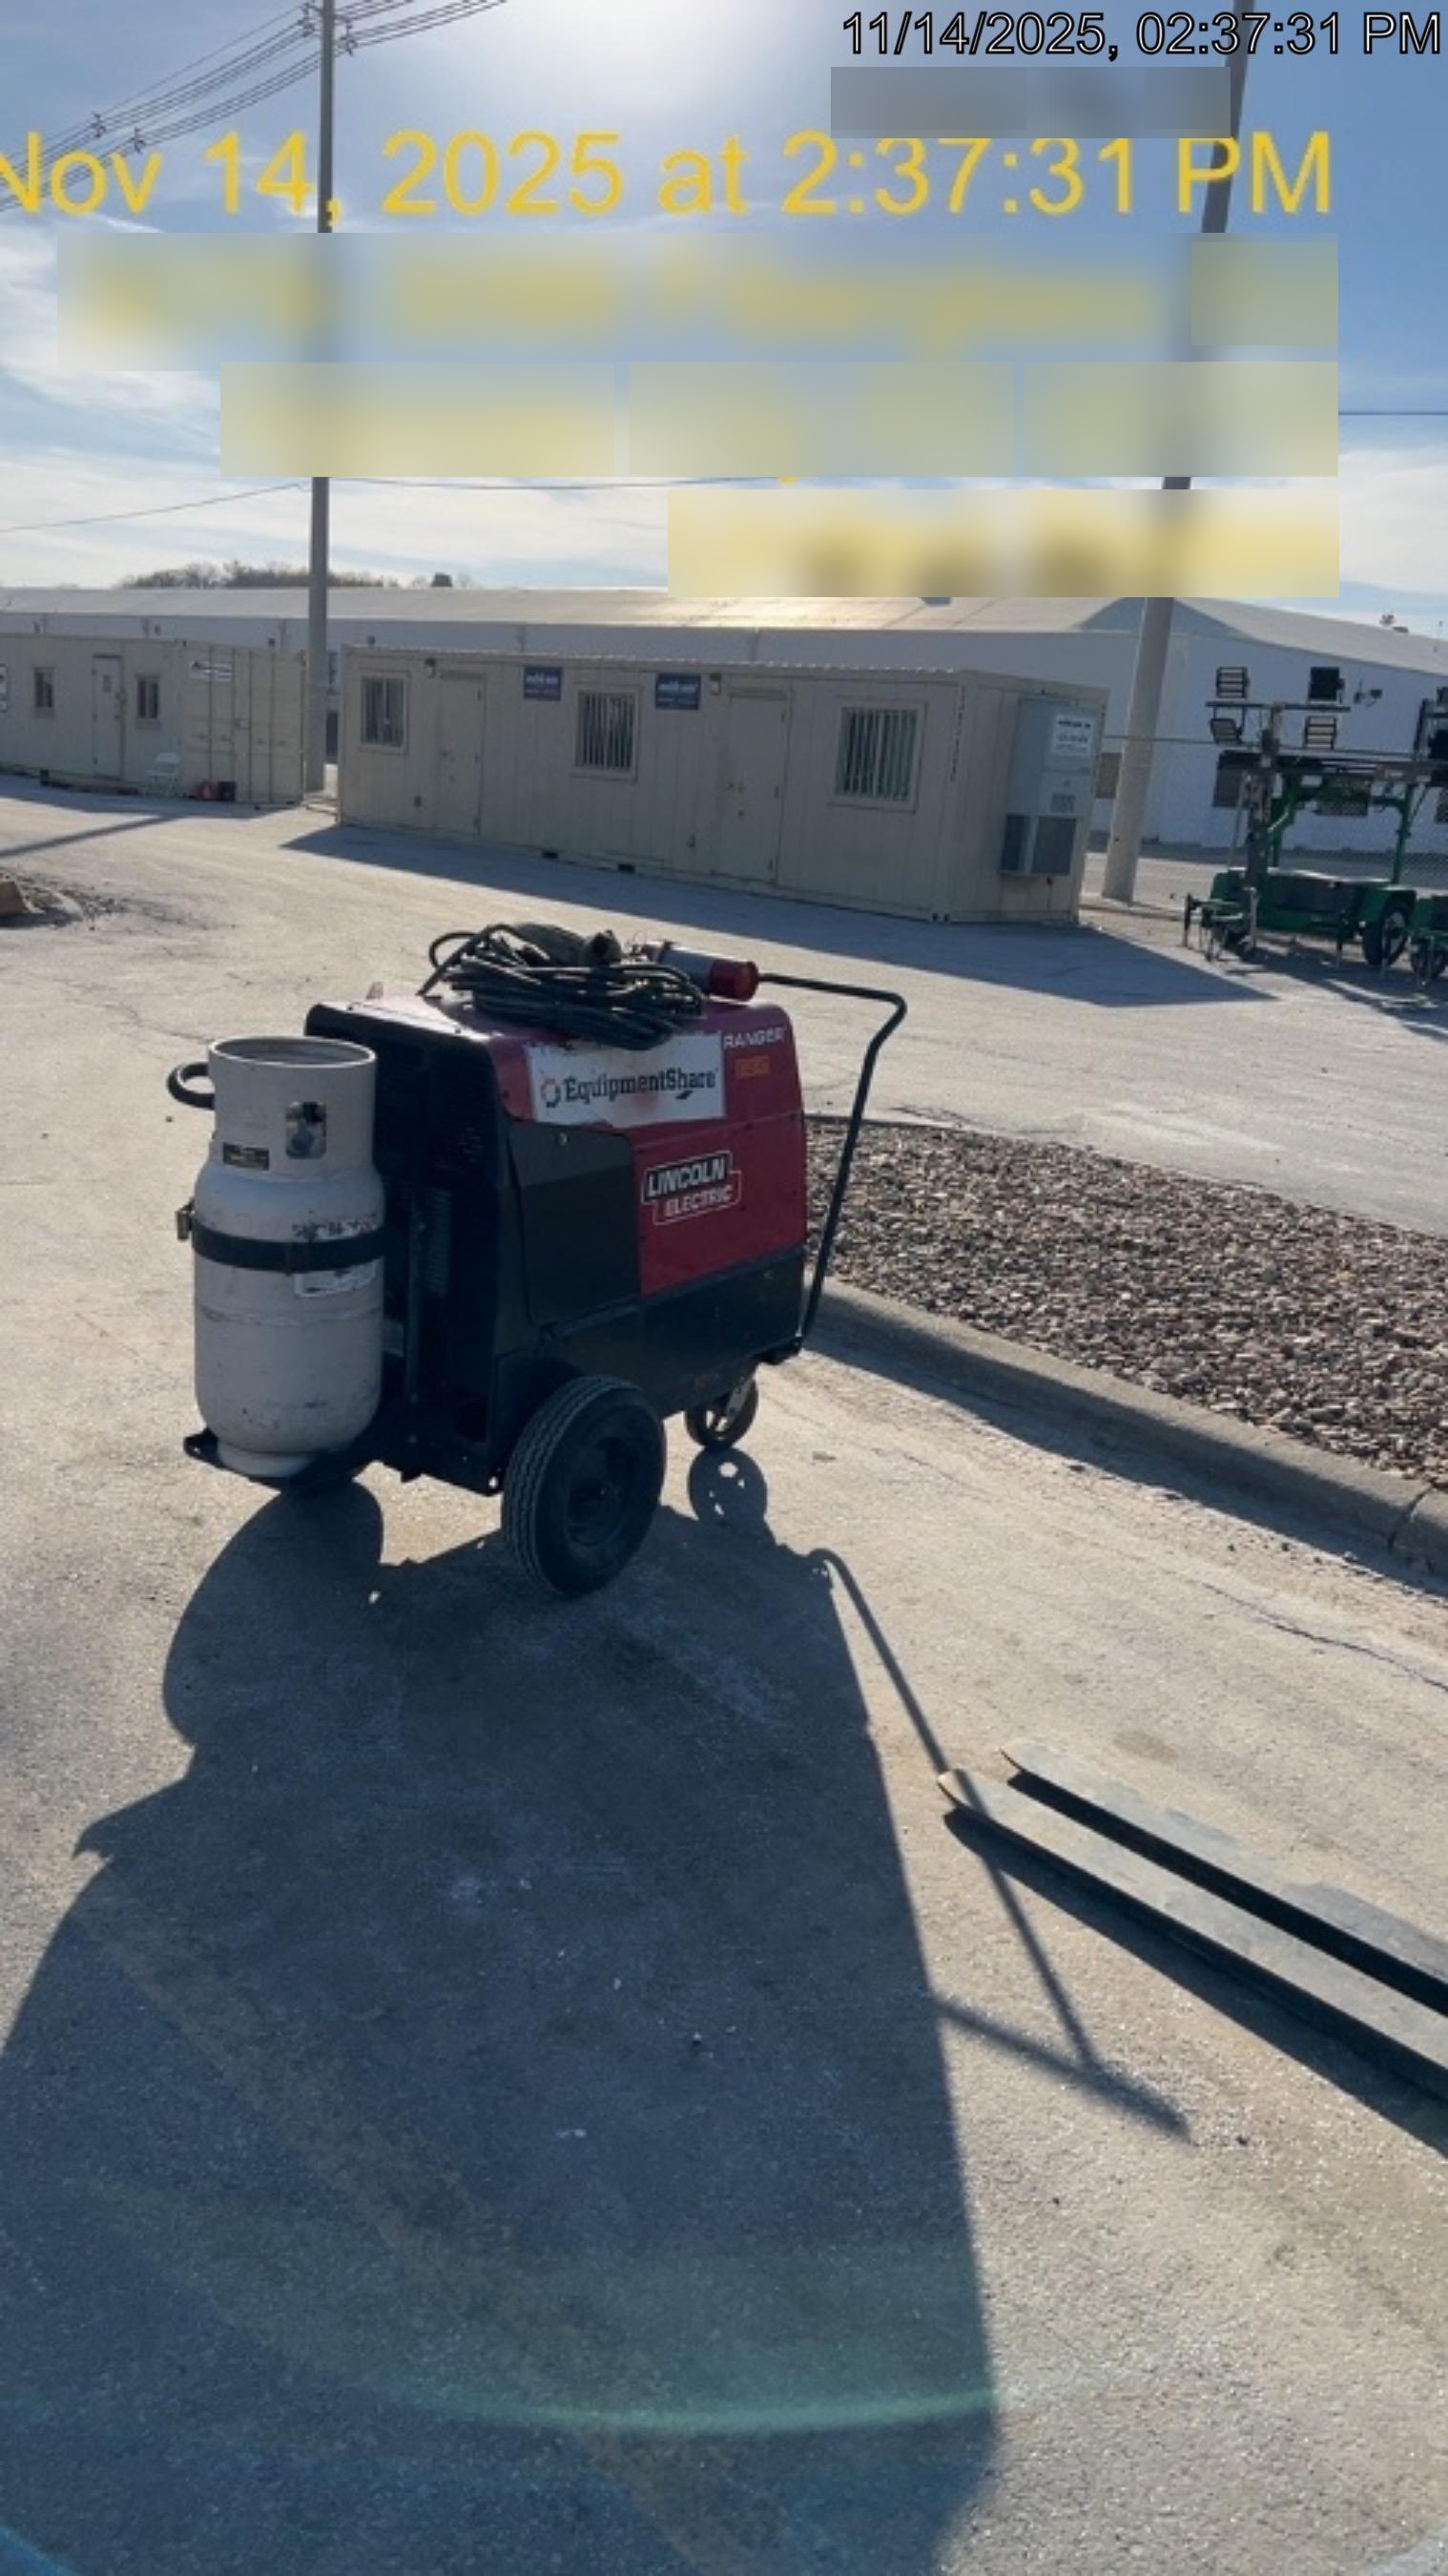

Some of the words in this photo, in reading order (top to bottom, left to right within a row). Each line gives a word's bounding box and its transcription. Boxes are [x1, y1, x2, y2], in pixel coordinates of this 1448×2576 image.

[723, 1027, 787, 1049] RANGER
[563, 1068, 717, 1105] EquipmentShare
[648, 1155, 727, 1197] LINCOLN
[664, 1183, 734, 1216] ELECTRIC
